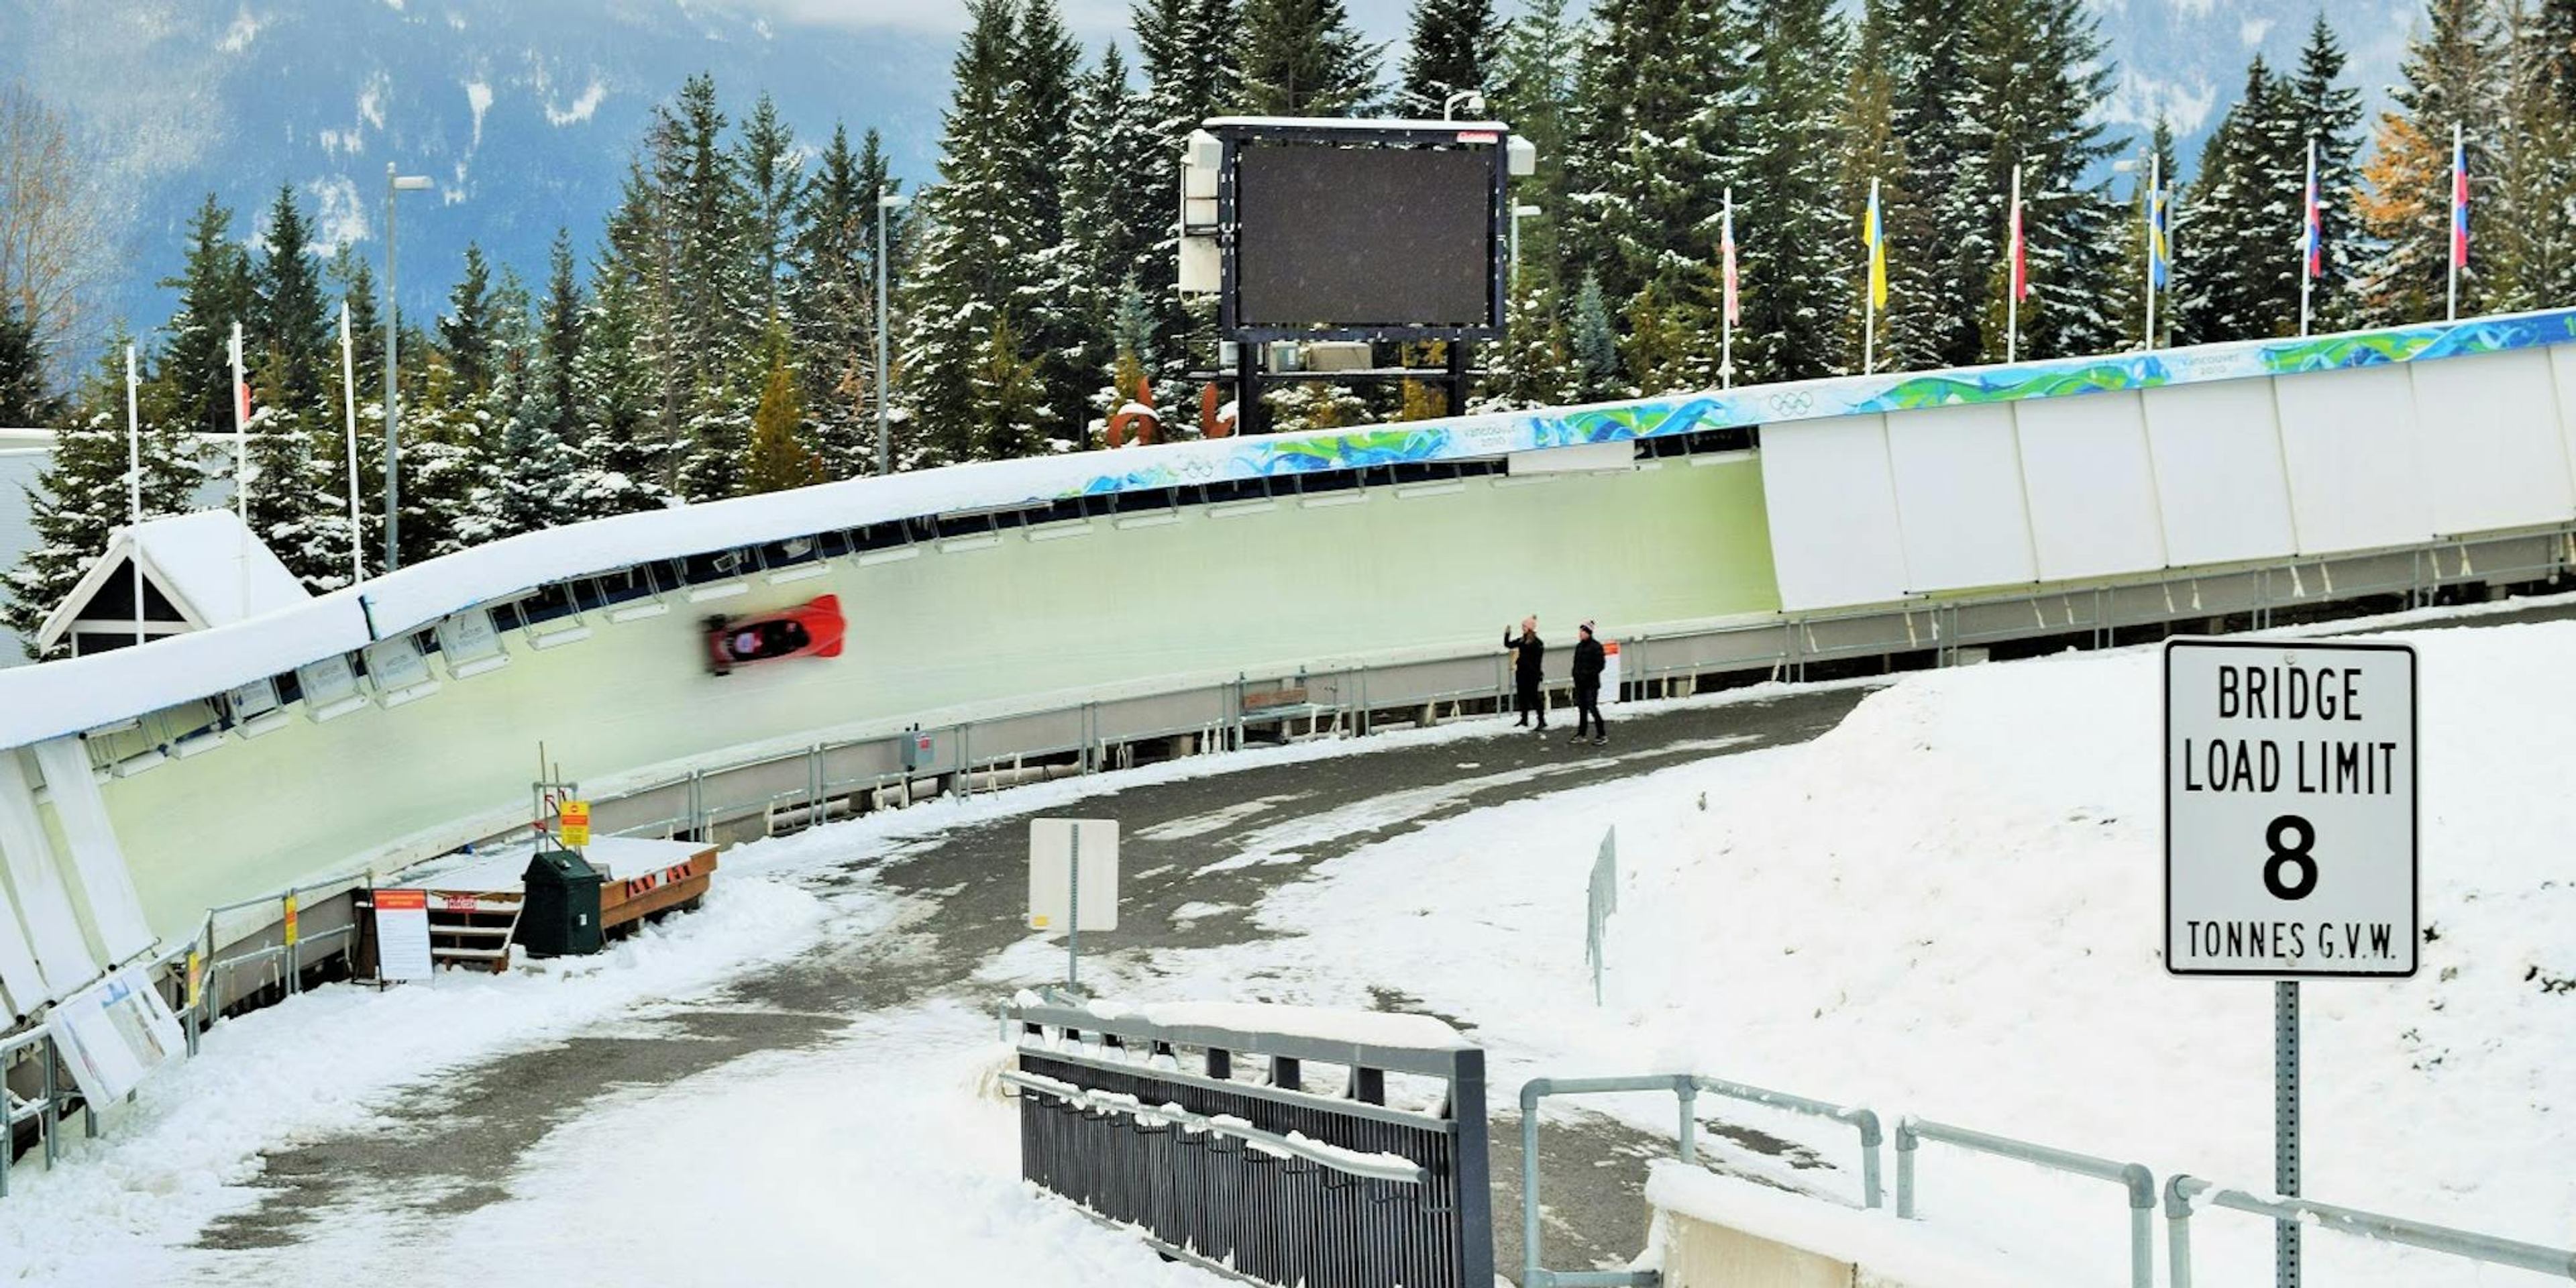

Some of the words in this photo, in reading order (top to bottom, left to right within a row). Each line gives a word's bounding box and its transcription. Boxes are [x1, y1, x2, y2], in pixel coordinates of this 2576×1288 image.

[2219, 665, 2362, 721] BRIDGE
[2185, 738, 2280, 792] LOAD
[2298, 741, 2396, 794] LIMIT
[2263, 814, 2318, 901] 8
[2187, 921, 2304, 959] TONNES
[2318, 922, 2396, 960] G.V.W.
